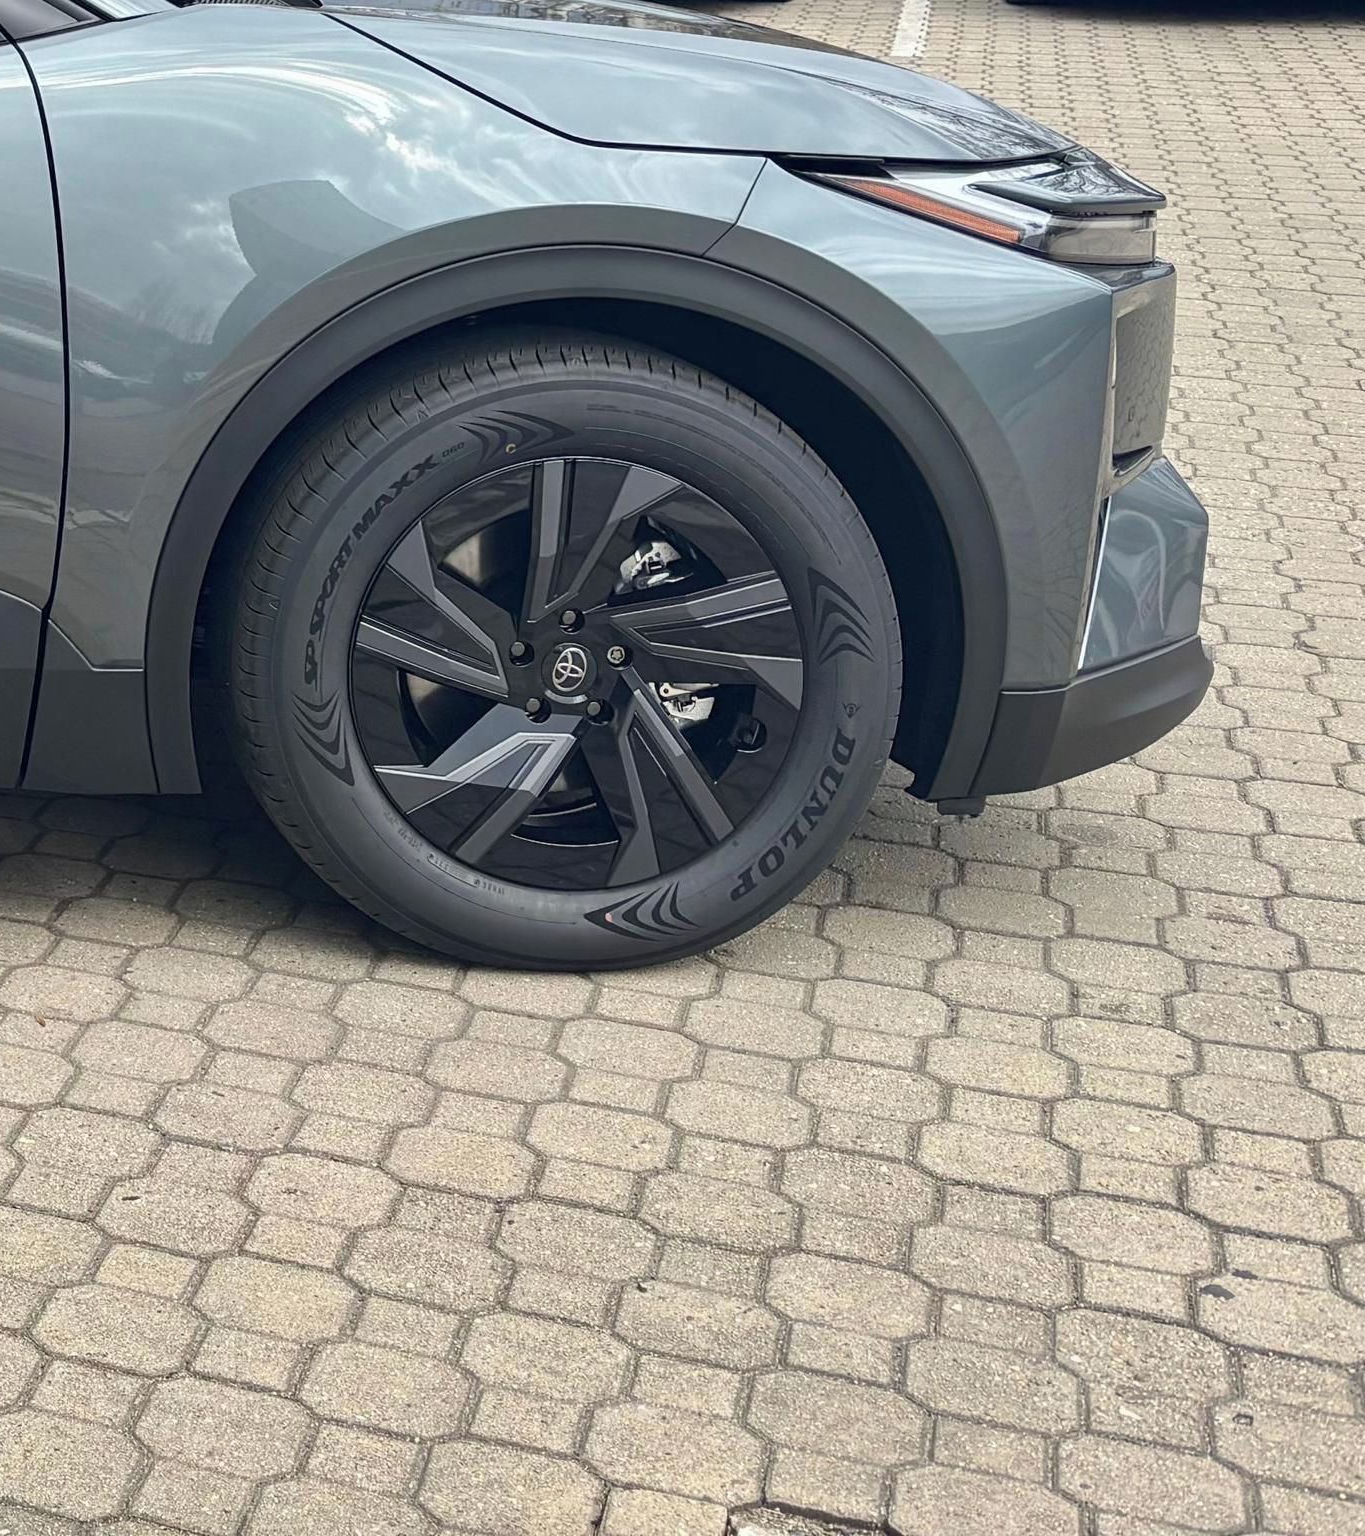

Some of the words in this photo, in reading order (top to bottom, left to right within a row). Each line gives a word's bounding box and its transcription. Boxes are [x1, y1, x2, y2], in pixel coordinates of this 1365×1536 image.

[309, 535, 354, 636] SPORT
[351, 454, 441, 541] MAXX
[730, 727, 857, 901] DUNLOP
